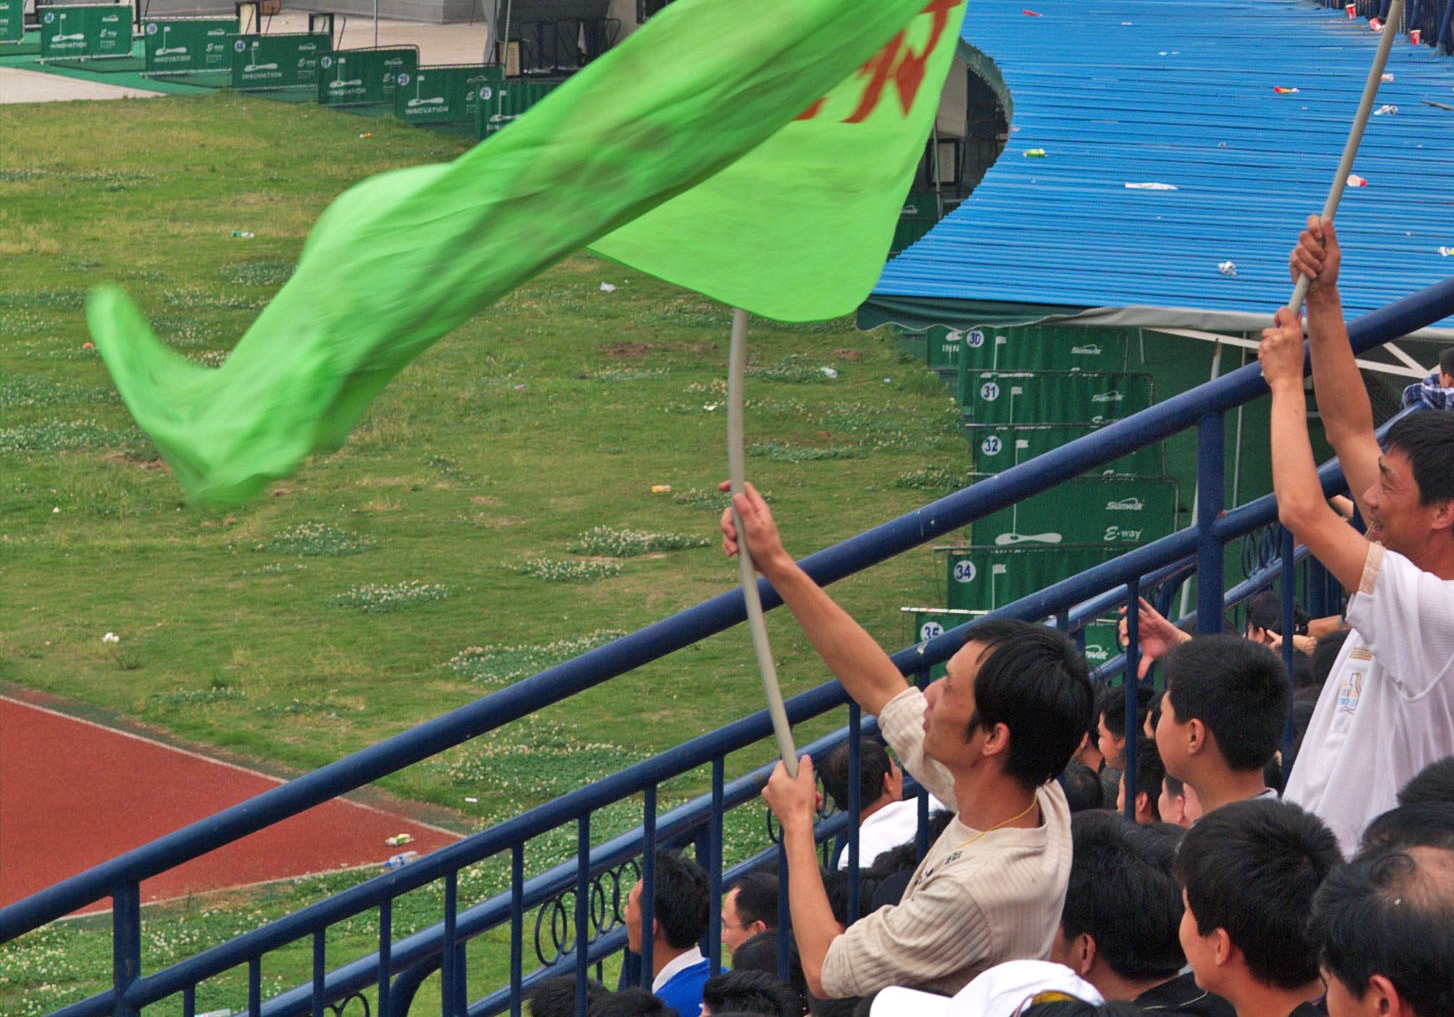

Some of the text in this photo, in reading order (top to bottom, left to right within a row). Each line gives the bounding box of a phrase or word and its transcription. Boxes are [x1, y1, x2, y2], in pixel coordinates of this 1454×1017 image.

[984, 385, 997, 399] 31
[985, 438, 998, 452] 32
[956, 564, 971, 580] 34
